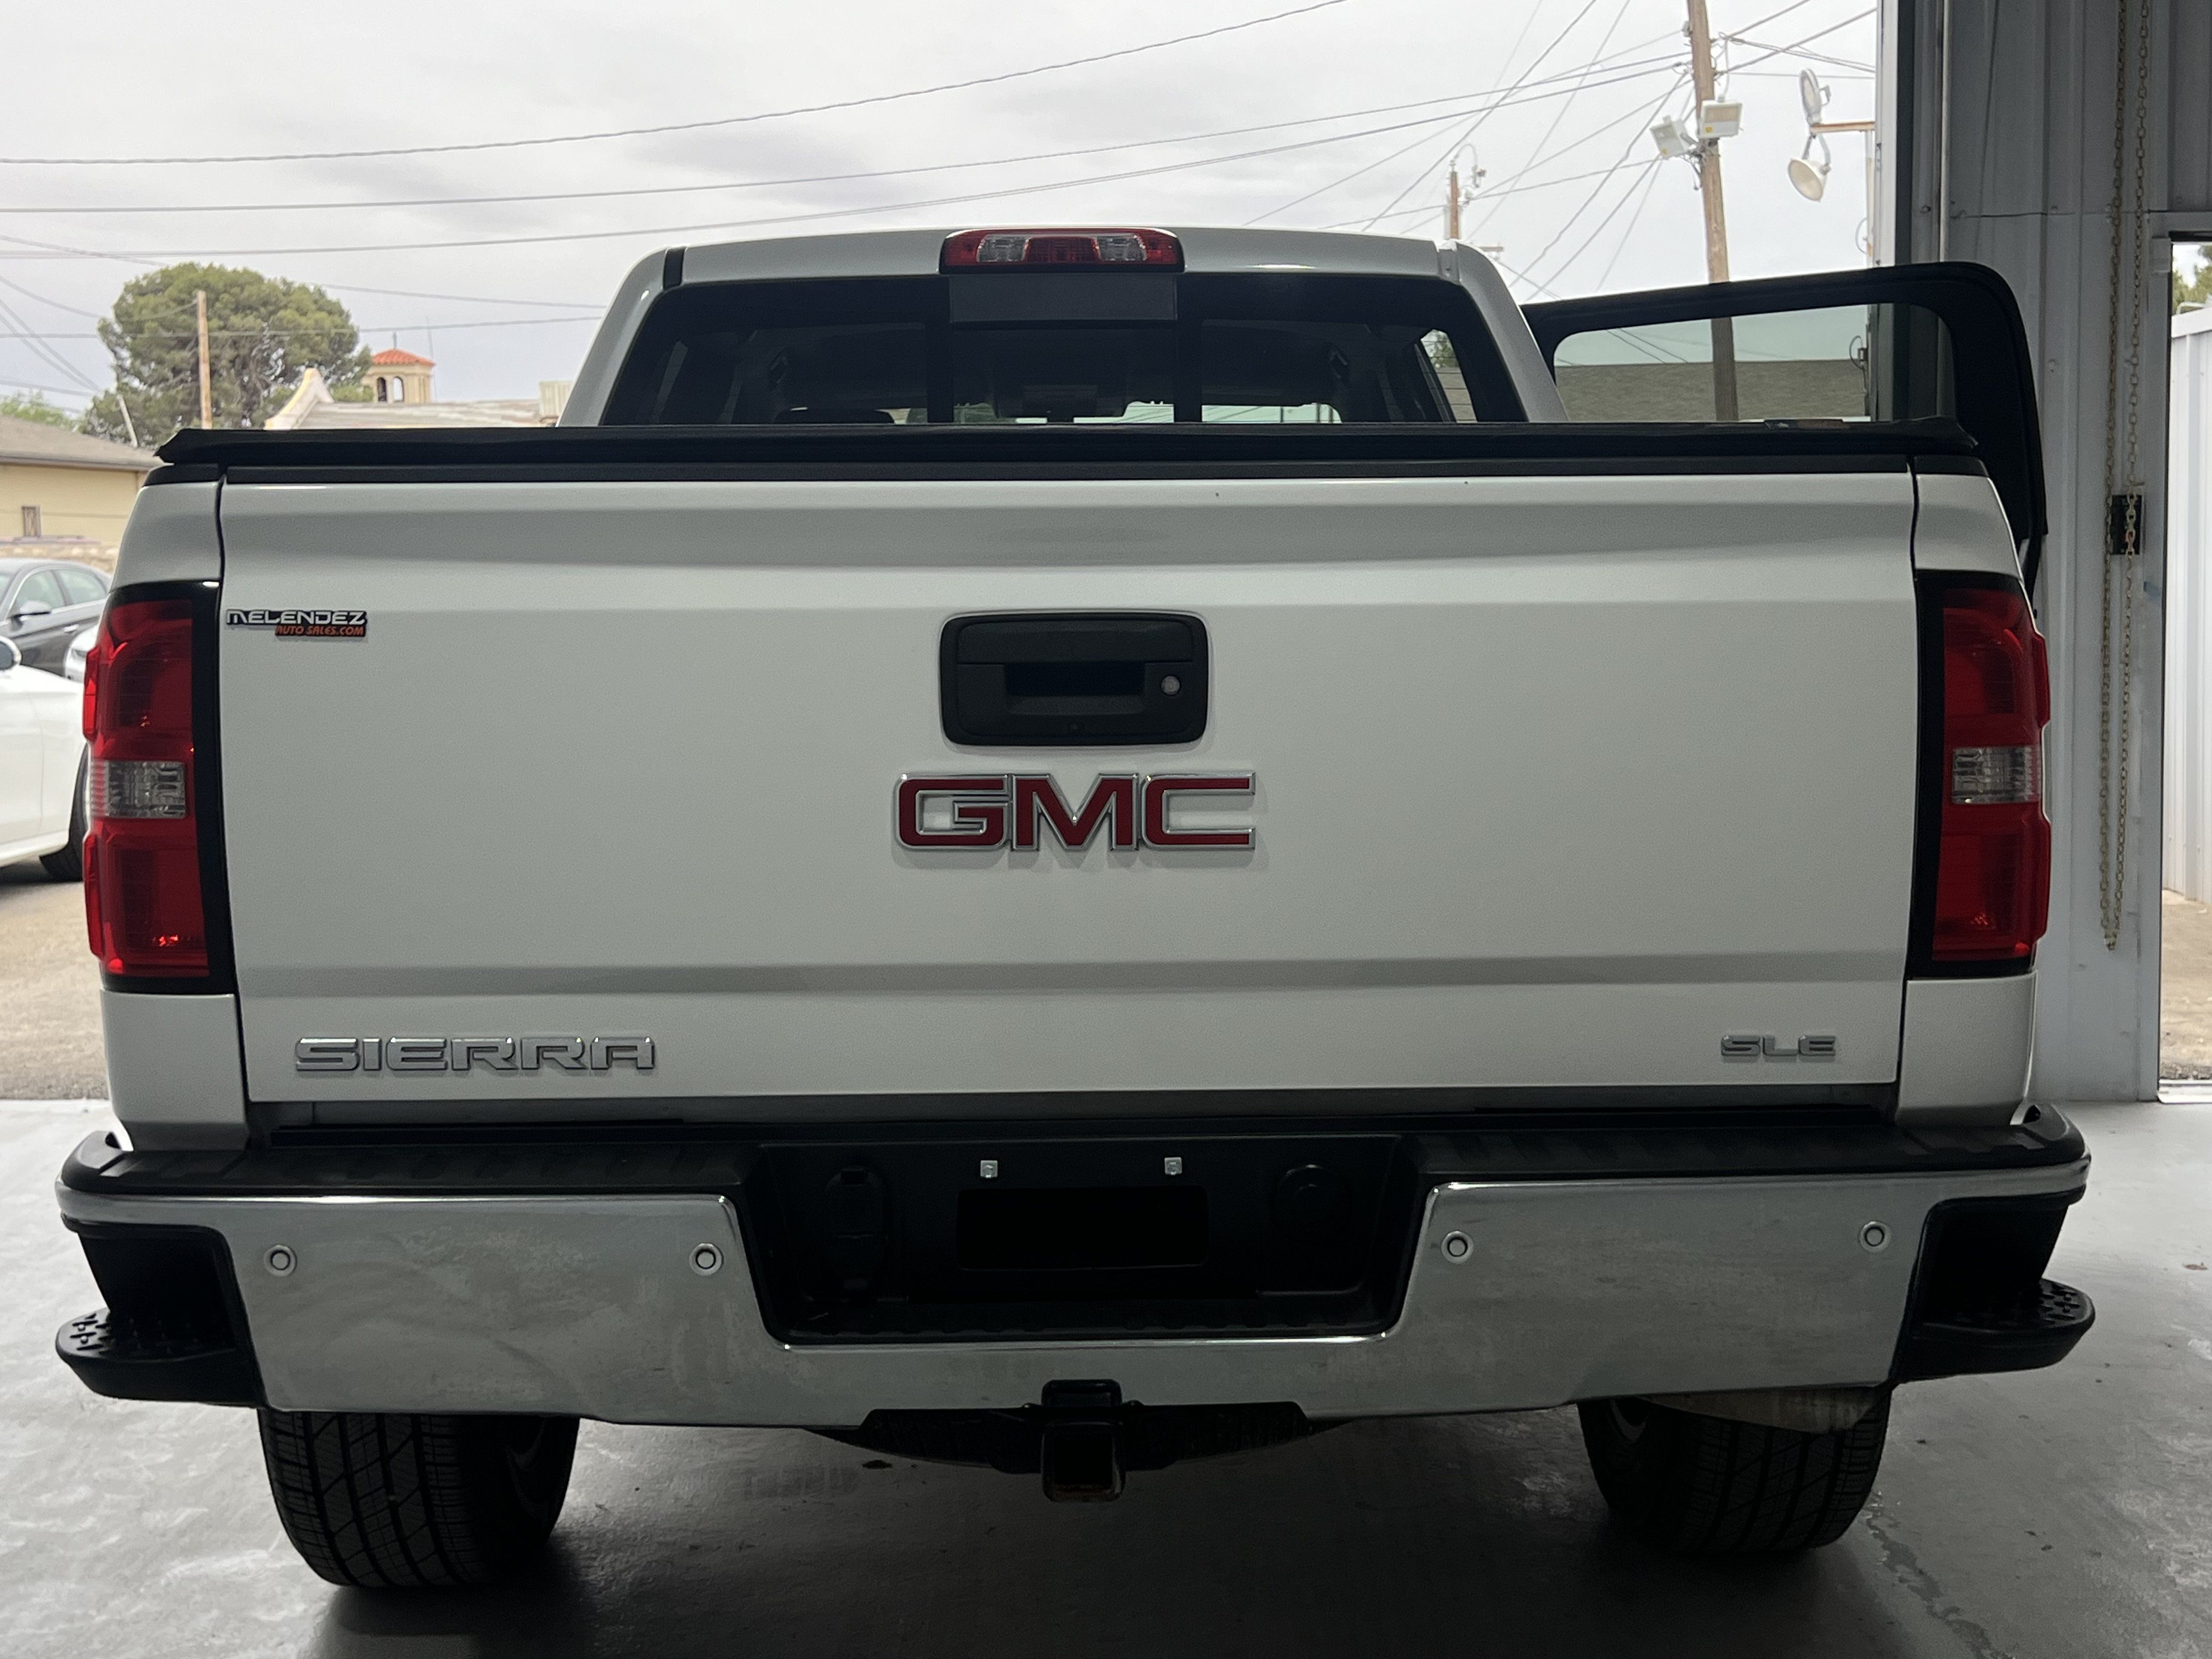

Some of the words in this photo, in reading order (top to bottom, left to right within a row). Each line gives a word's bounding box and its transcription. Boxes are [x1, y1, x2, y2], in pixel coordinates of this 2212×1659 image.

[226, 610, 366, 624] MELENDEZ
[895, 772, 1256, 851] GMC
[296, 1037, 655, 1071] SIERRA
[1720, 1035, 1836, 1057] SLE
